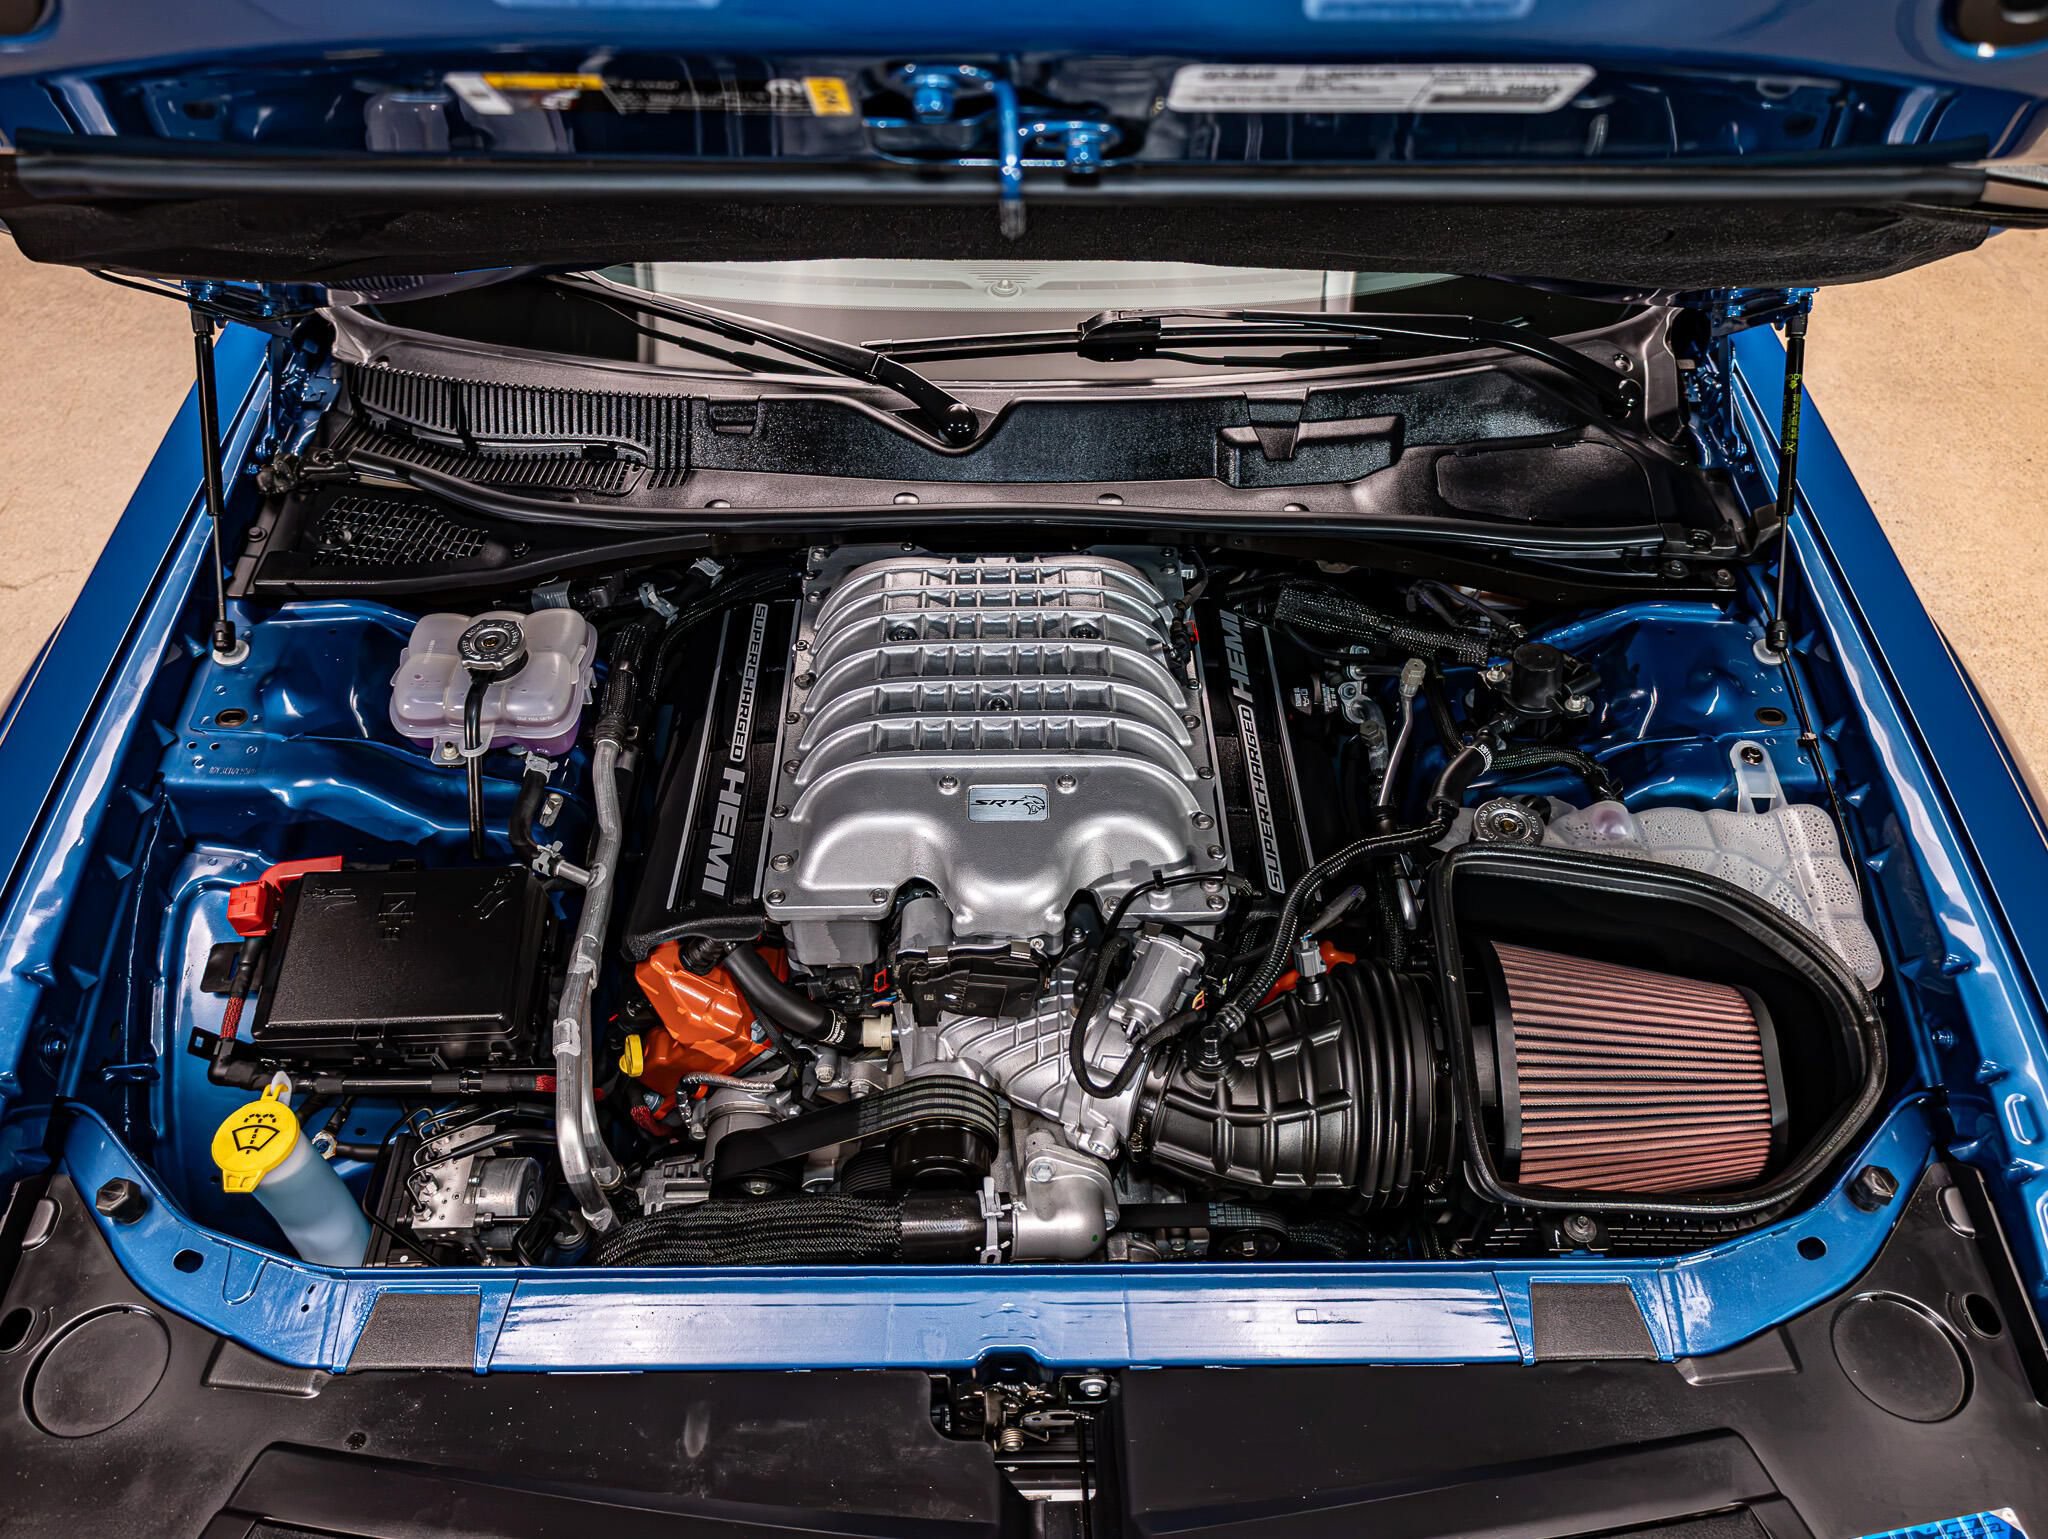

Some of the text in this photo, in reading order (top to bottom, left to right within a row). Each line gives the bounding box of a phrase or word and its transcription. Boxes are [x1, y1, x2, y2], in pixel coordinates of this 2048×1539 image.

[702, 603, 768, 896] SUPERCHARGED HEMI
[971, 799, 1025, 808] SRT
[1219, 609, 1286, 894] SUPERCHARGED HEMI
